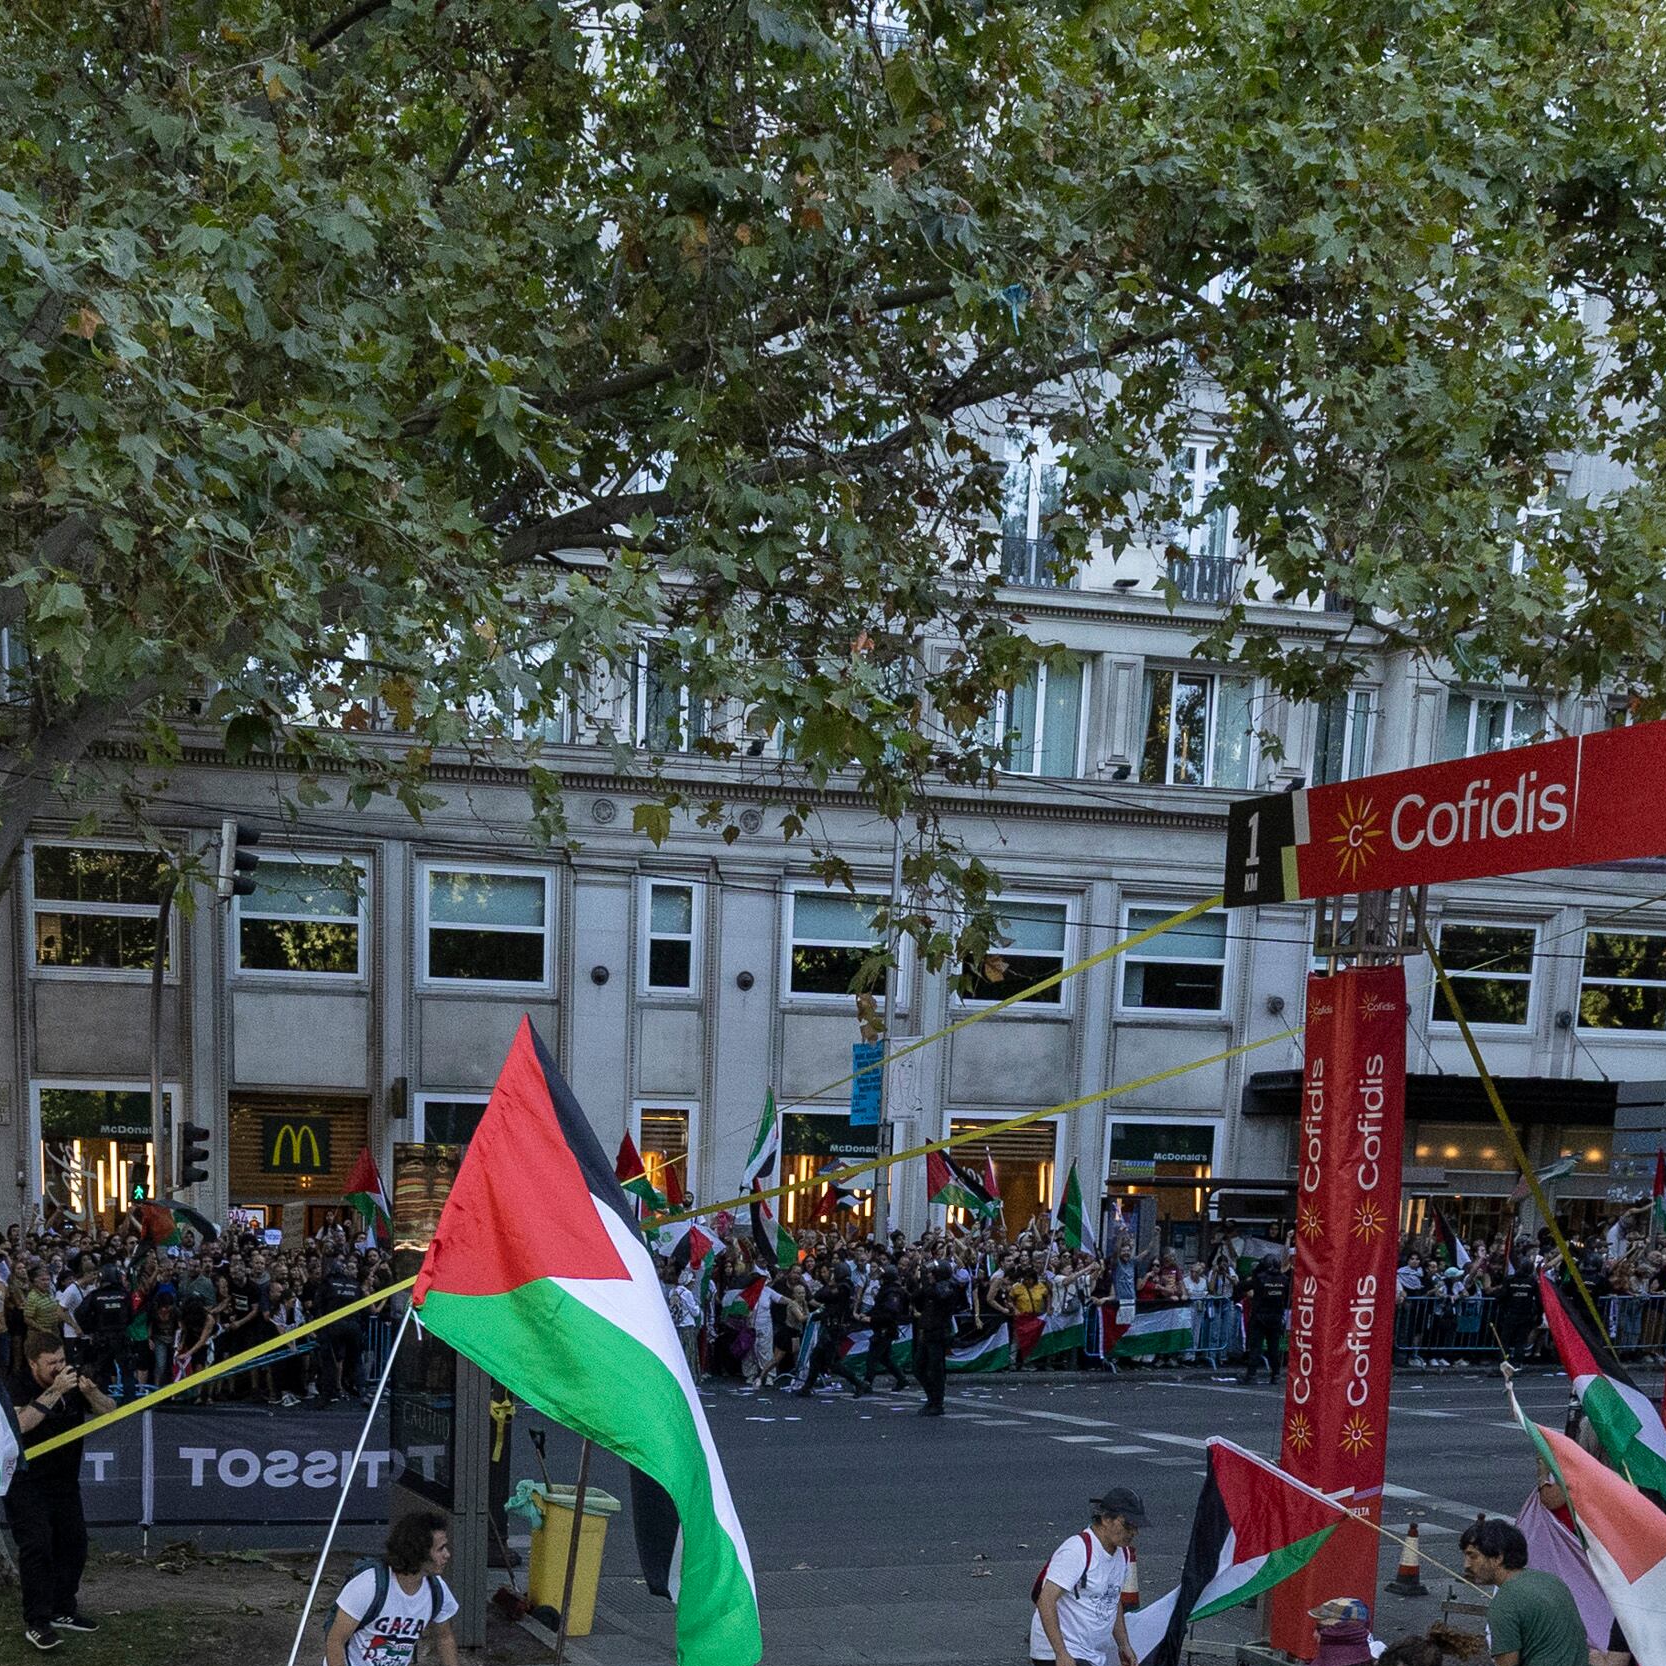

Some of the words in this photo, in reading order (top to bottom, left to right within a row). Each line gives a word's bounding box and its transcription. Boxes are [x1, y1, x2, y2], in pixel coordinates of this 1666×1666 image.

[1246, 811, 1260, 867] 1
[1391, 771, 1568, 852] Cofidis
[1244, 872, 1259, 893] KM
[1304, 1057, 1324, 1192] Cofidis
[1358, 1054, 1384, 1190] Cofidis
[1293, 1275, 1318, 1405] Cofidis
[1347, 1274, 1378, 1407] Cofidis
[375, 1616, 424, 1636] GAZA
